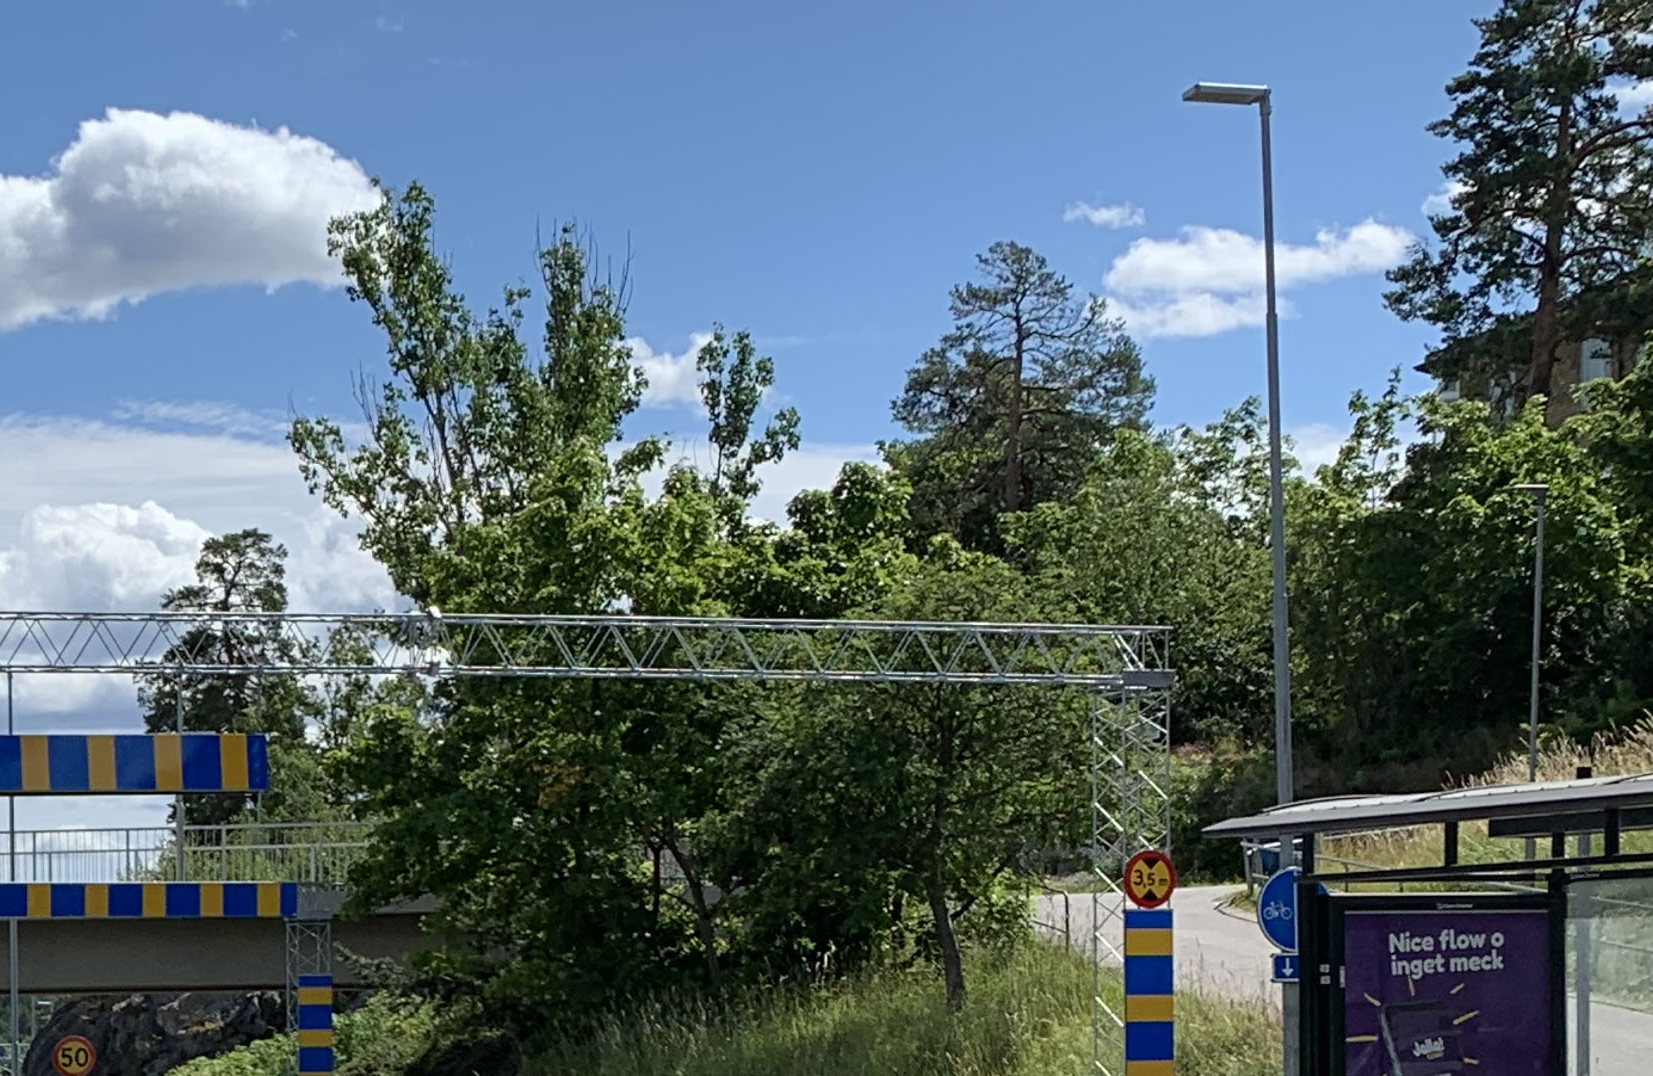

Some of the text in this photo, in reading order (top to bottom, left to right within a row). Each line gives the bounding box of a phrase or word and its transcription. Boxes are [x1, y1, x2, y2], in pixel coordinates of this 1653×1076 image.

[1133, 869, 1168, 889] 3,5 m
[1389, 928, 1505, 953] Nice flow o
[1391, 949, 1504, 980] inget meck
[61, 1047, 88, 1067] 50
